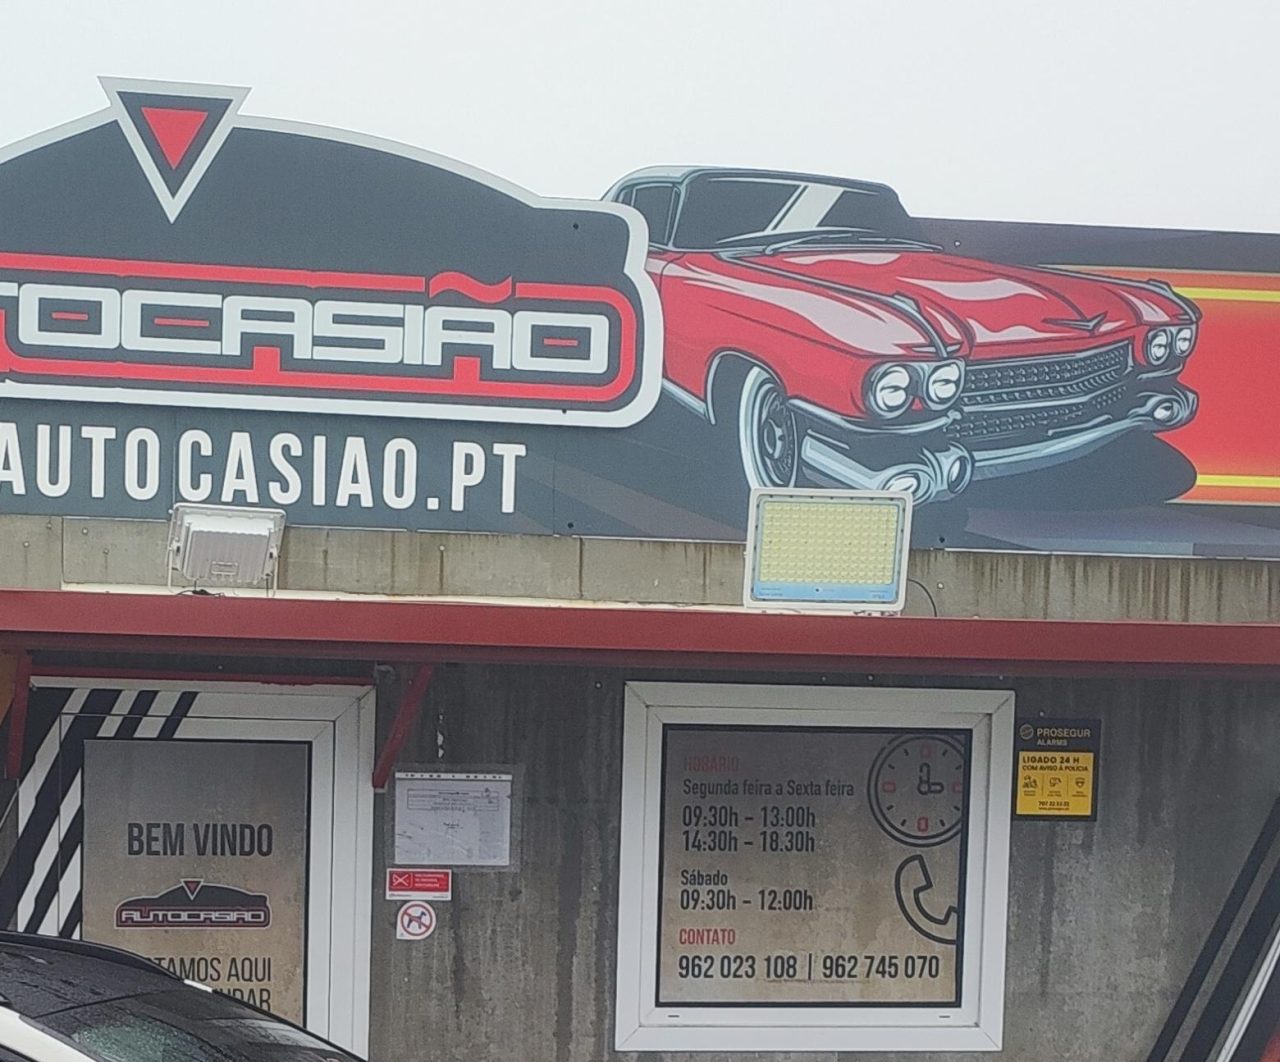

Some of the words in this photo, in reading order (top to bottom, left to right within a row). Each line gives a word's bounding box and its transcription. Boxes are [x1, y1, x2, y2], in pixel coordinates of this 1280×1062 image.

[1036, 728, 1091, 738] PROSEGUR
[1022, 756, 1057, 764] LIGADO
[683, 778, 739, 799] Segunda
[743, 780, 771, 795] feira
[775, 784, 783, 796] a
[787, 780, 821, 796] Sexta
[825, 780, 855, 797] feira
[682, 805, 739, 827] 09:30h
[760, 806, 816, 828] 13:00h
[127, 823, 185, 856] BEM
[192, 823, 273, 857] VINDO
[682, 829, 738, 852] 14:30h
[759, 830, 816, 852] 18.30h
[680, 869, 728, 886] Sábado
[680, 889, 737, 910] 09:30h
[758, 889, 814, 911] 12:00h
[679, 928, 736, 945] CONTATO
[227, 957, 272, 982] AQUI
[678, 955, 715, 979] 962
[720, 955, 756, 979] 023
[764, 955, 798, 979] 108
[822, 955, 859, 979] 962
[864, 955, 899, 979] 745
[904, 955, 940, 979] 070
